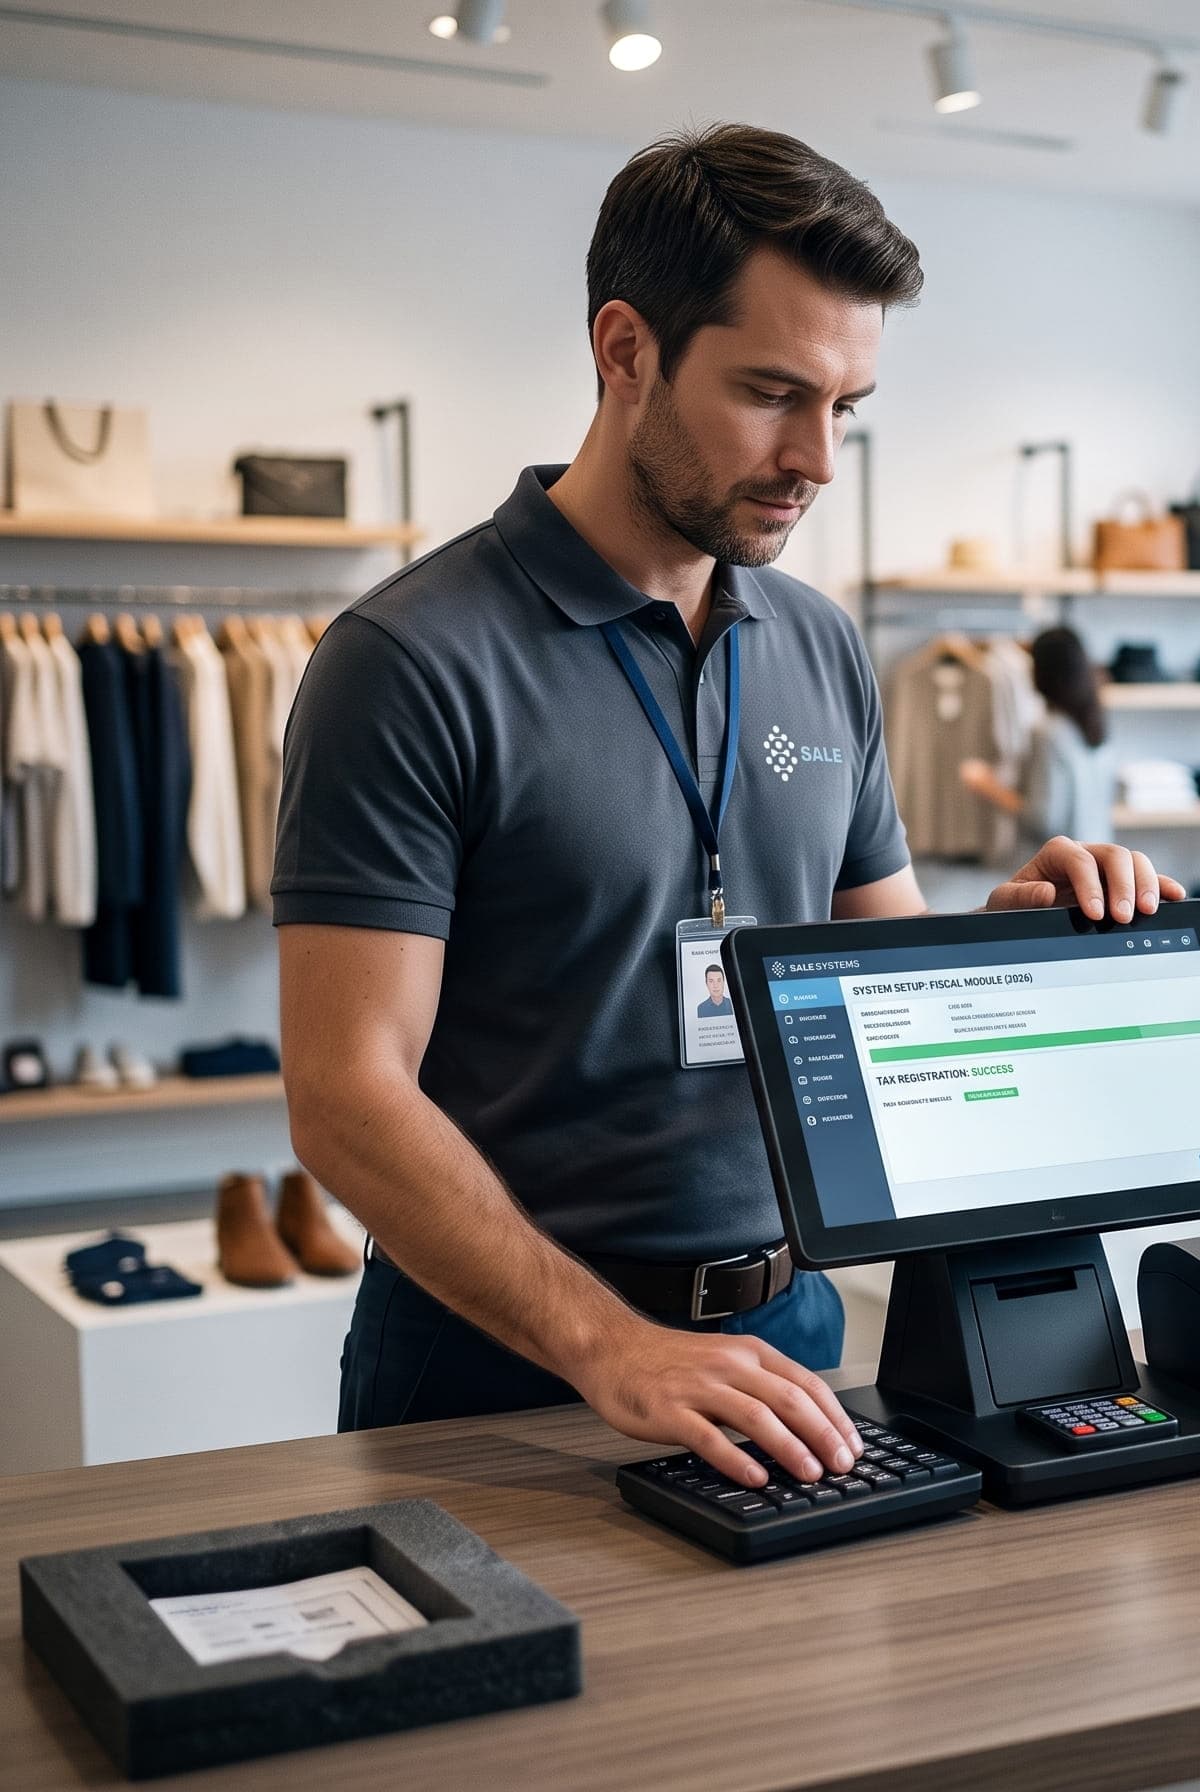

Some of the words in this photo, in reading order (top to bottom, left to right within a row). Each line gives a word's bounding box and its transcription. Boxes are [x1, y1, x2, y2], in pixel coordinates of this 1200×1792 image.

[800, 745, 843, 763] SALE
[852, 984, 892, 996] SYSTEM
[894, 981, 929, 993] SETUP:
[929, 978, 963, 990] FISCAL
[963, 975, 1003, 987] MODULE
[876, 1074, 896, 1087] TAX
[898, 1067, 970, 1085] REGISTRATION:
[971, 1064, 1014, 1077] SUCCESS
